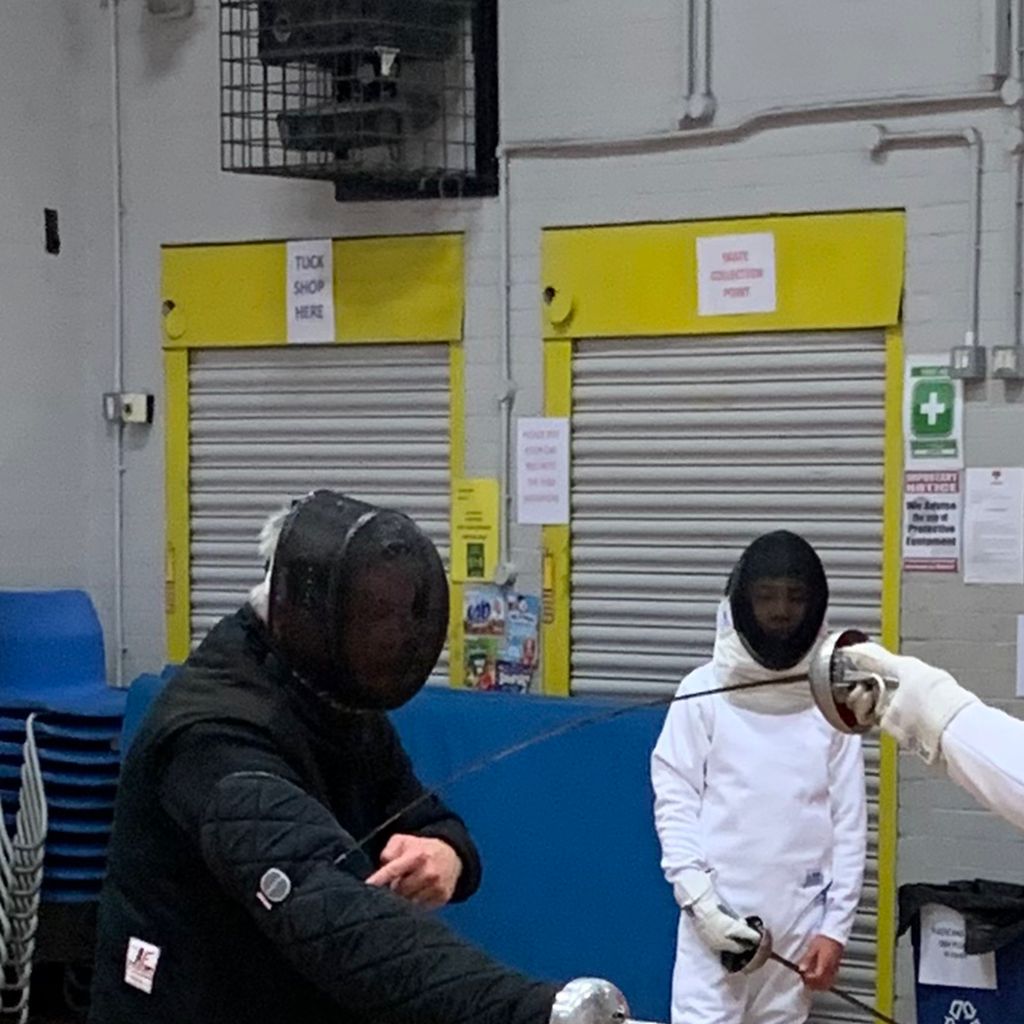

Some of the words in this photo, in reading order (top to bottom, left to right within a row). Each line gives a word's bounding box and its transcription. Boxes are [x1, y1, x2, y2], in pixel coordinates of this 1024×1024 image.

[294, 254, 325, 271] TUCK
[293, 280, 325, 295] SHOP
[294, 304, 325, 320] HERE
[905, 482, 958, 493] NOTICE
